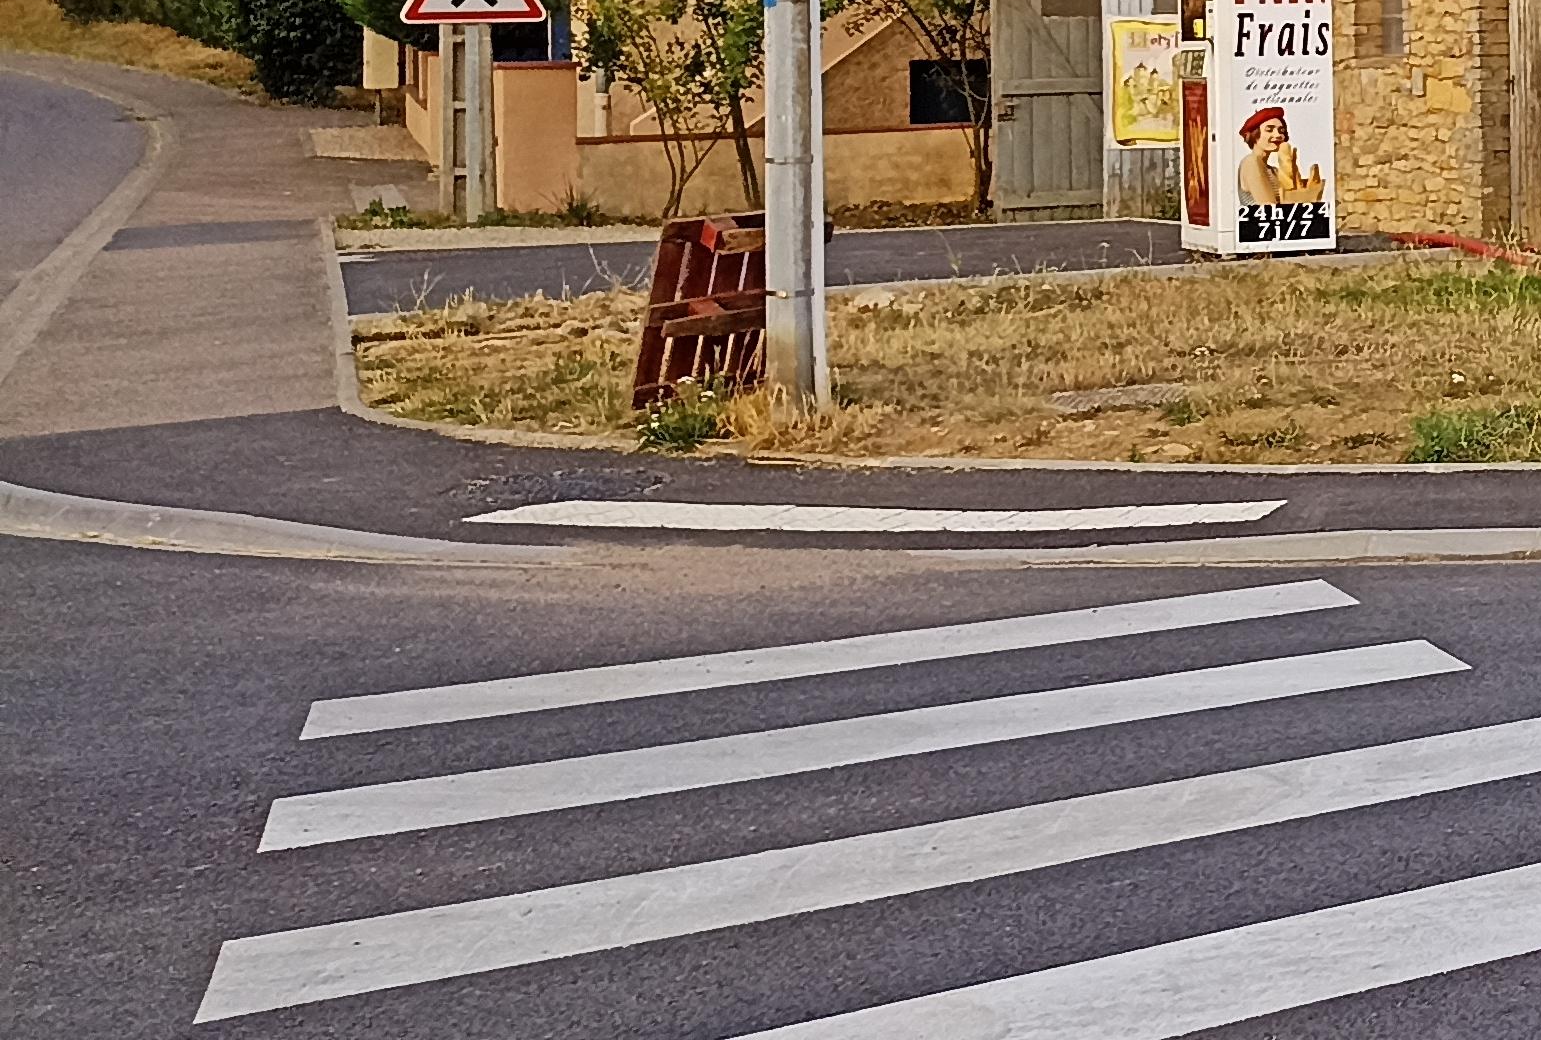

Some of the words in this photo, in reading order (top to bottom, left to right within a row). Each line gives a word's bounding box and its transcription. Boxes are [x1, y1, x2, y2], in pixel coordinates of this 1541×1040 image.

[1234, 9, 1330, 57] Frais
[1245, 79, 1258, 91] de
[1263, 79, 1320, 96] baguettes
[1238, 202, 1330, 223] 24h/24
[1257, 219, 1312, 242] 7j/7
